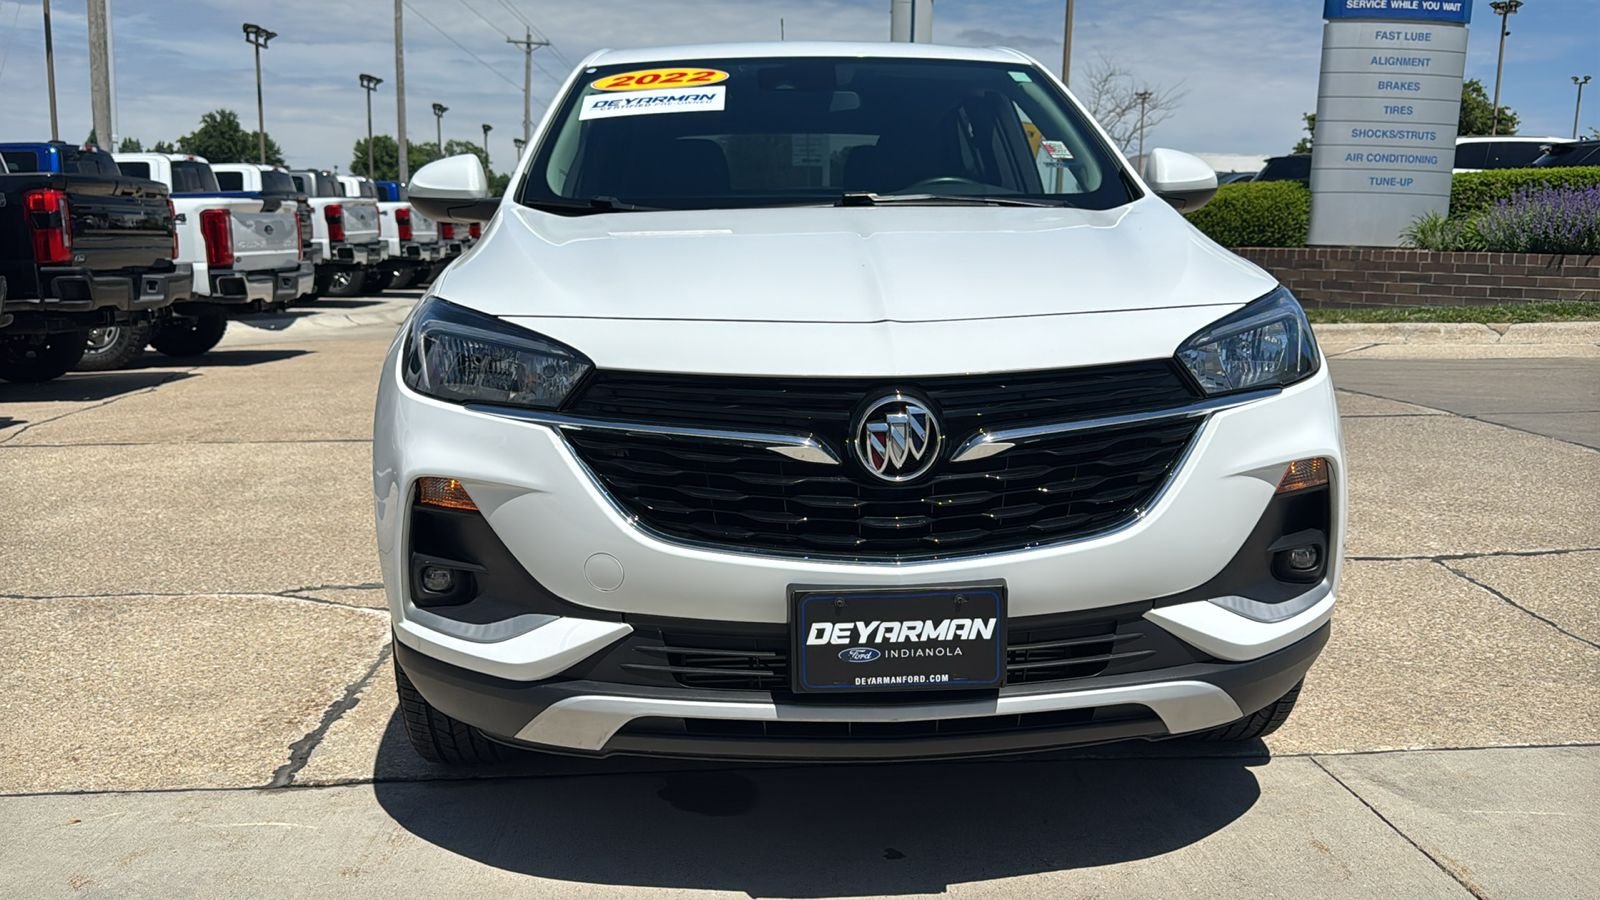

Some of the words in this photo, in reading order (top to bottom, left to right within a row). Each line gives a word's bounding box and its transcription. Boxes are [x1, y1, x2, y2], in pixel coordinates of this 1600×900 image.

[1346, 0, 1387, 9] SERVICE
[1391, 0, 1419, 10] WHILE
[1422, 1, 1440, 11] YOU
[1442, 3, 1462, 12] WAIT
[1375, 31, 1401, 41] FAST
[1404, 32, 1432, 42] LUBE
[1370, 56, 1431, 67] ALIGNMENT
[605, 71, 717, 89] 2022
[1377, 81, 1421, 92] BRAKES
[592, 93, 716, 109] DEYARMAN
[1384, 105, 1413, 115] TIRES
[1351, 128, 1437, 141] SHOCKS/STRUTS
[1345, 153, 1363, 163] AIR
[1366, 153, 1438, 165] CONDITIONING
[1369, 177, 1414, 187] TUNE-UP
[806, 618, 997, 646] DEYARMAN
[885, 647, 963, 658] INDIANOLA
[855, 674, 949, 686] DEYARMANFORD.COM
